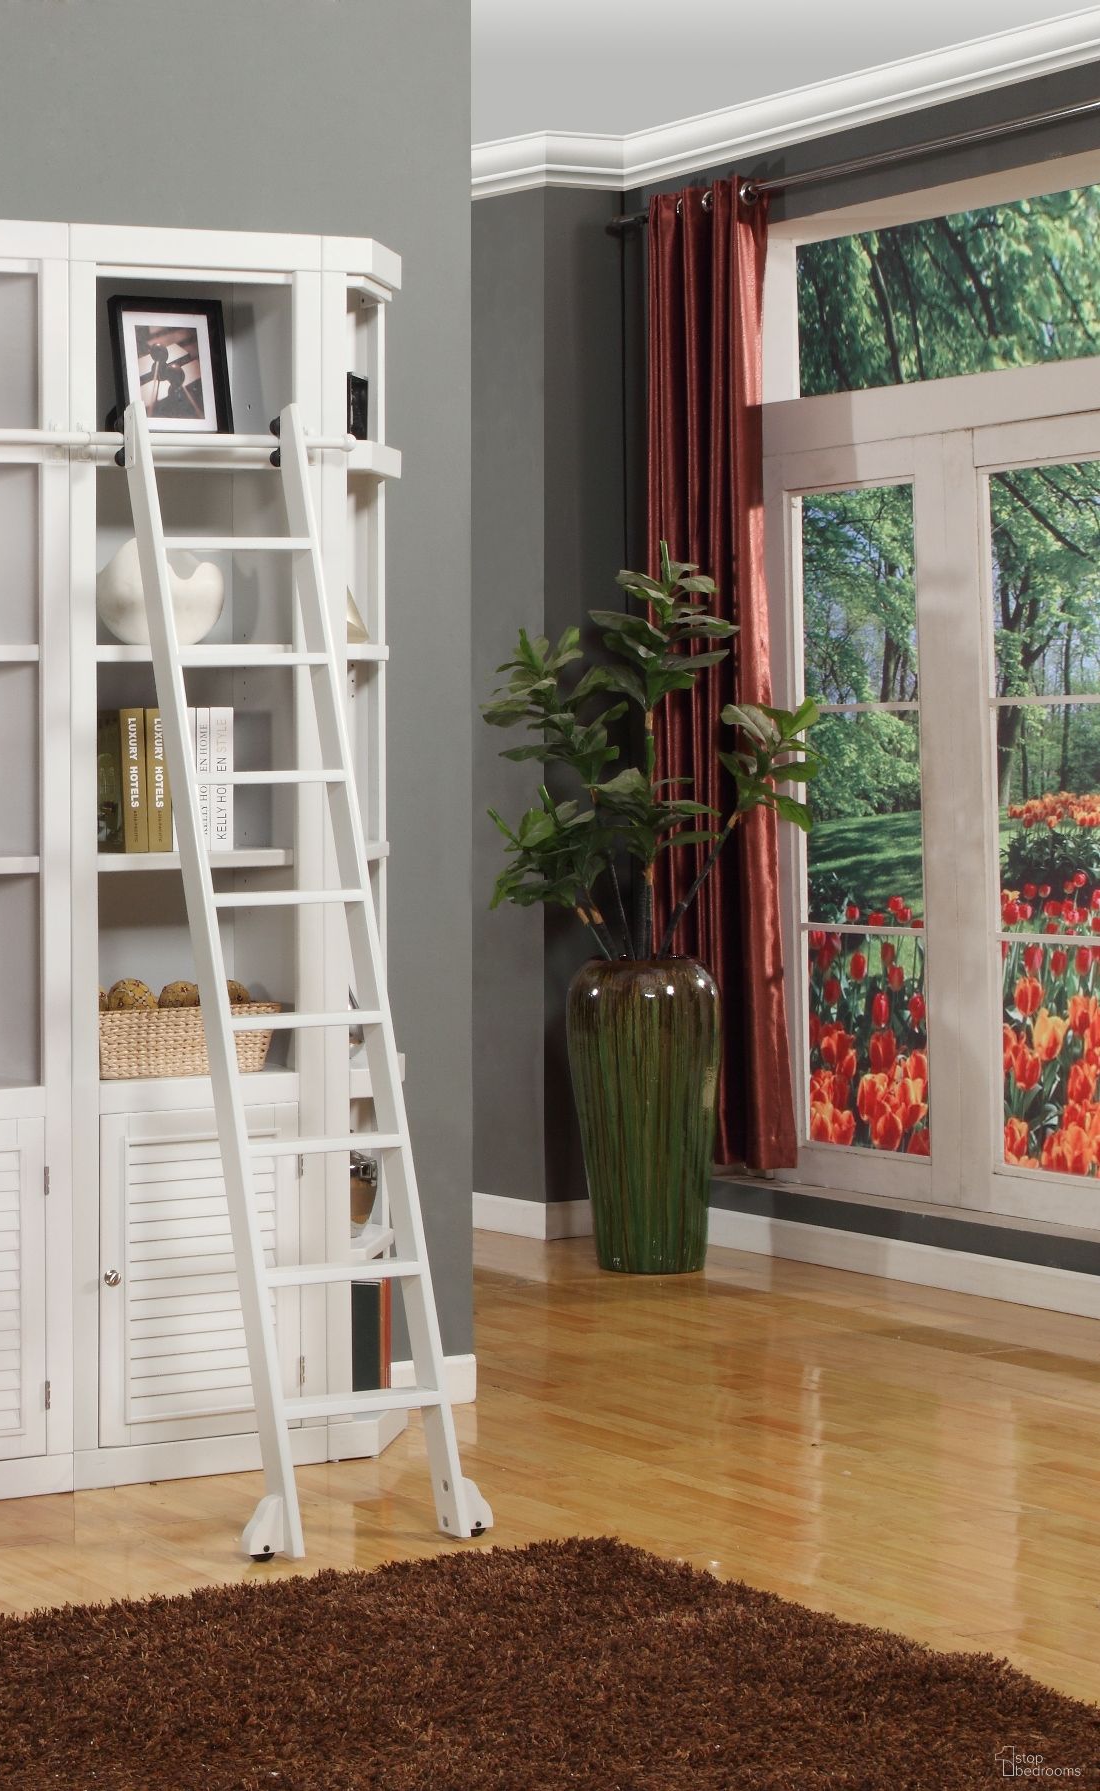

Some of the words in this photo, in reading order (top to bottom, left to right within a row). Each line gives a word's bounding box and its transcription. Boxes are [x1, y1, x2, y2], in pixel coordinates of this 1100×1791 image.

[127, 718, 138, 761] LUXURY
[154, 718, 164, 761] LUXURY
[200, 724, 208, 755] HOME
[216, 719, 227, 753] STYLE
[129, 766, 140, 808] HOTELS
[154, 766, 164, 808] HOTELS
[216, 757, 227, 803] HOEN
[216, 806, 227, 840] KELLY
